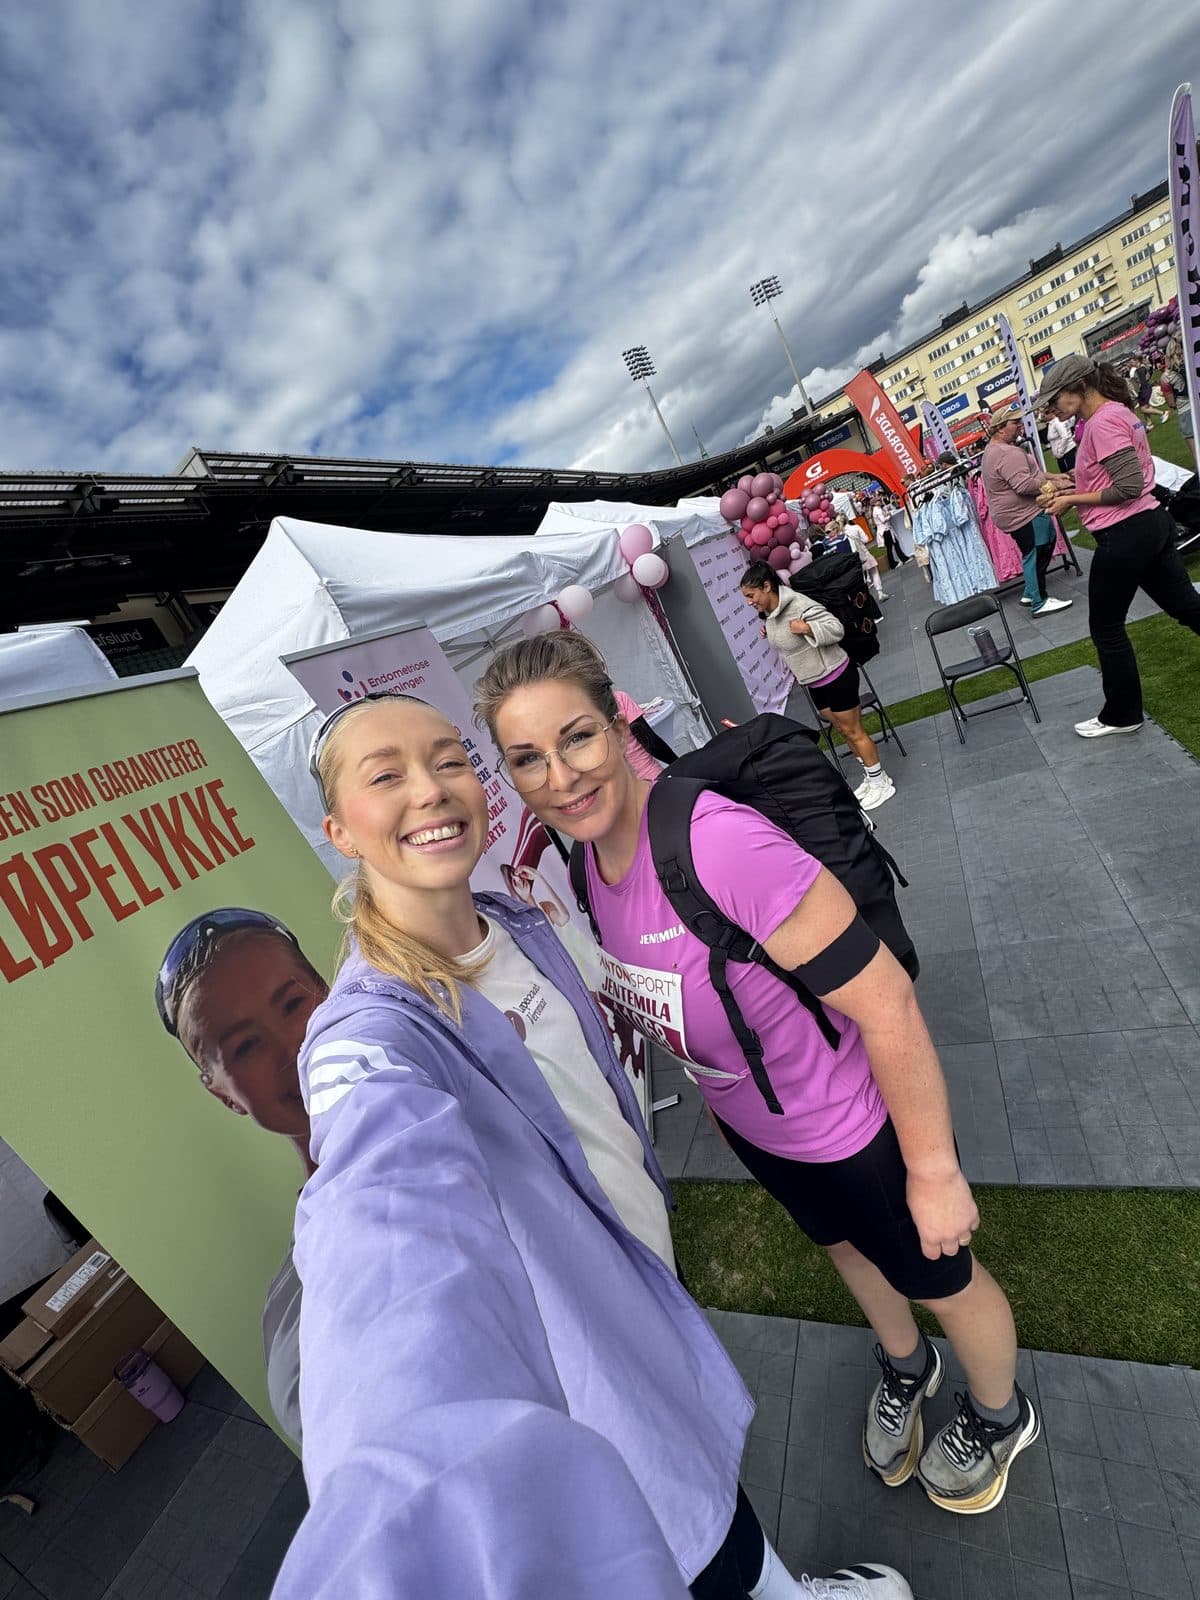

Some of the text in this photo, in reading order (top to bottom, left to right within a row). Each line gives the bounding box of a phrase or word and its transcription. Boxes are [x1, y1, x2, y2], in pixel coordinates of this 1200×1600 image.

[995, 373, 1015, 388] OBOS
[941, 401, 961, 416] OBOS
[805, 461, 823, 479] G
[367, 659, 431, 688] Endometriose
[388, 675, 426, 695] eningen
[31, 773, 98, 823] SOM
[87, 738, 209, 802] GARANTERER
[488, 779, 502, 796] LIV
[487, 796, 508, 821] ORLIG
[602, 976, 671, 1023] JENTEMILA
